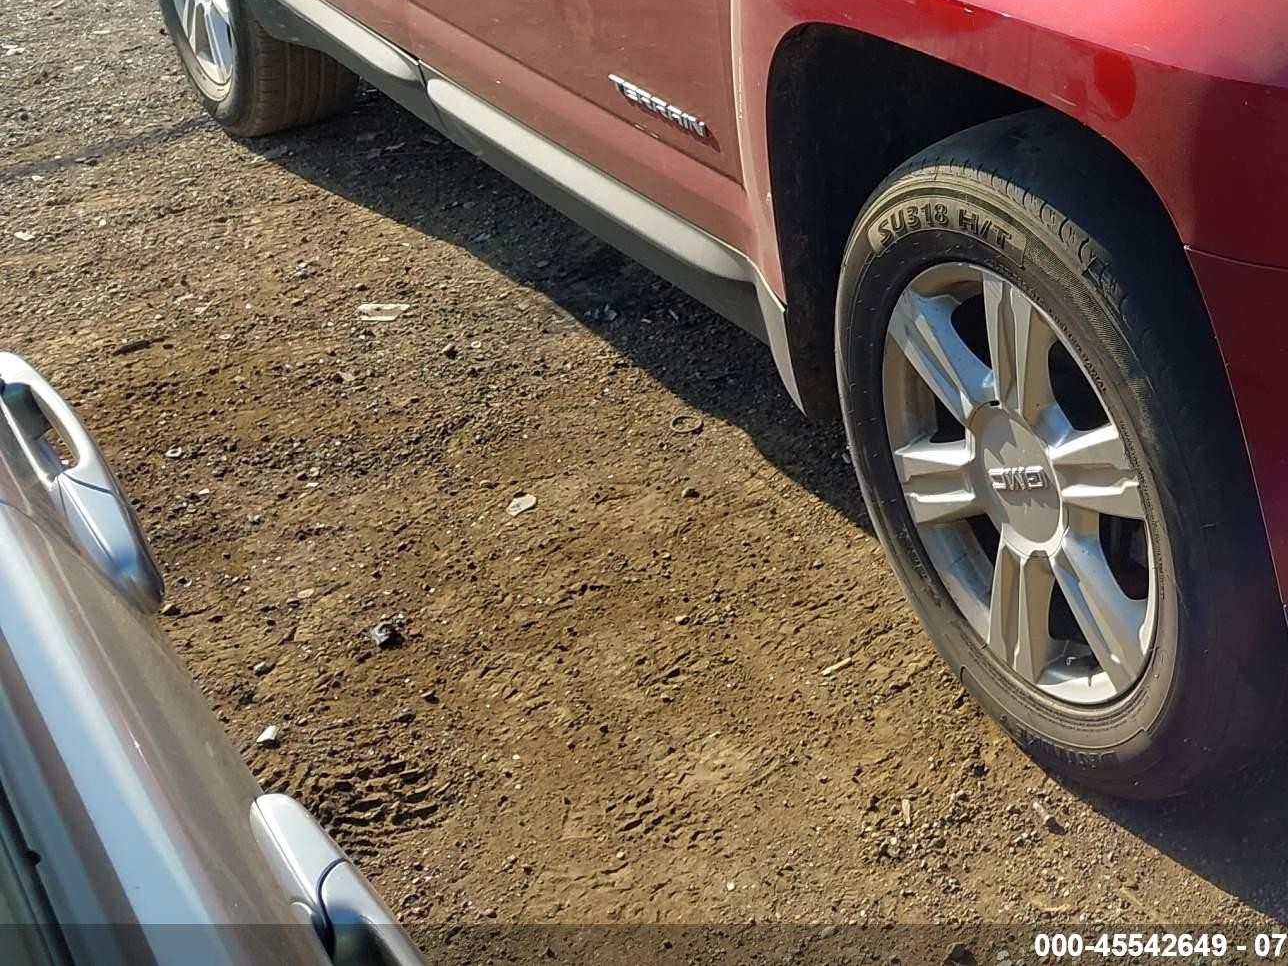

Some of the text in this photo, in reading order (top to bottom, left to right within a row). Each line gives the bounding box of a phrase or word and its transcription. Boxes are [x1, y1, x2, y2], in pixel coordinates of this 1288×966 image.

[608, 73, 706, 139] TERRAIN
[877, 202, 1014, 251] SU318 H/T
[987, 465, 1048, 491] GMC
